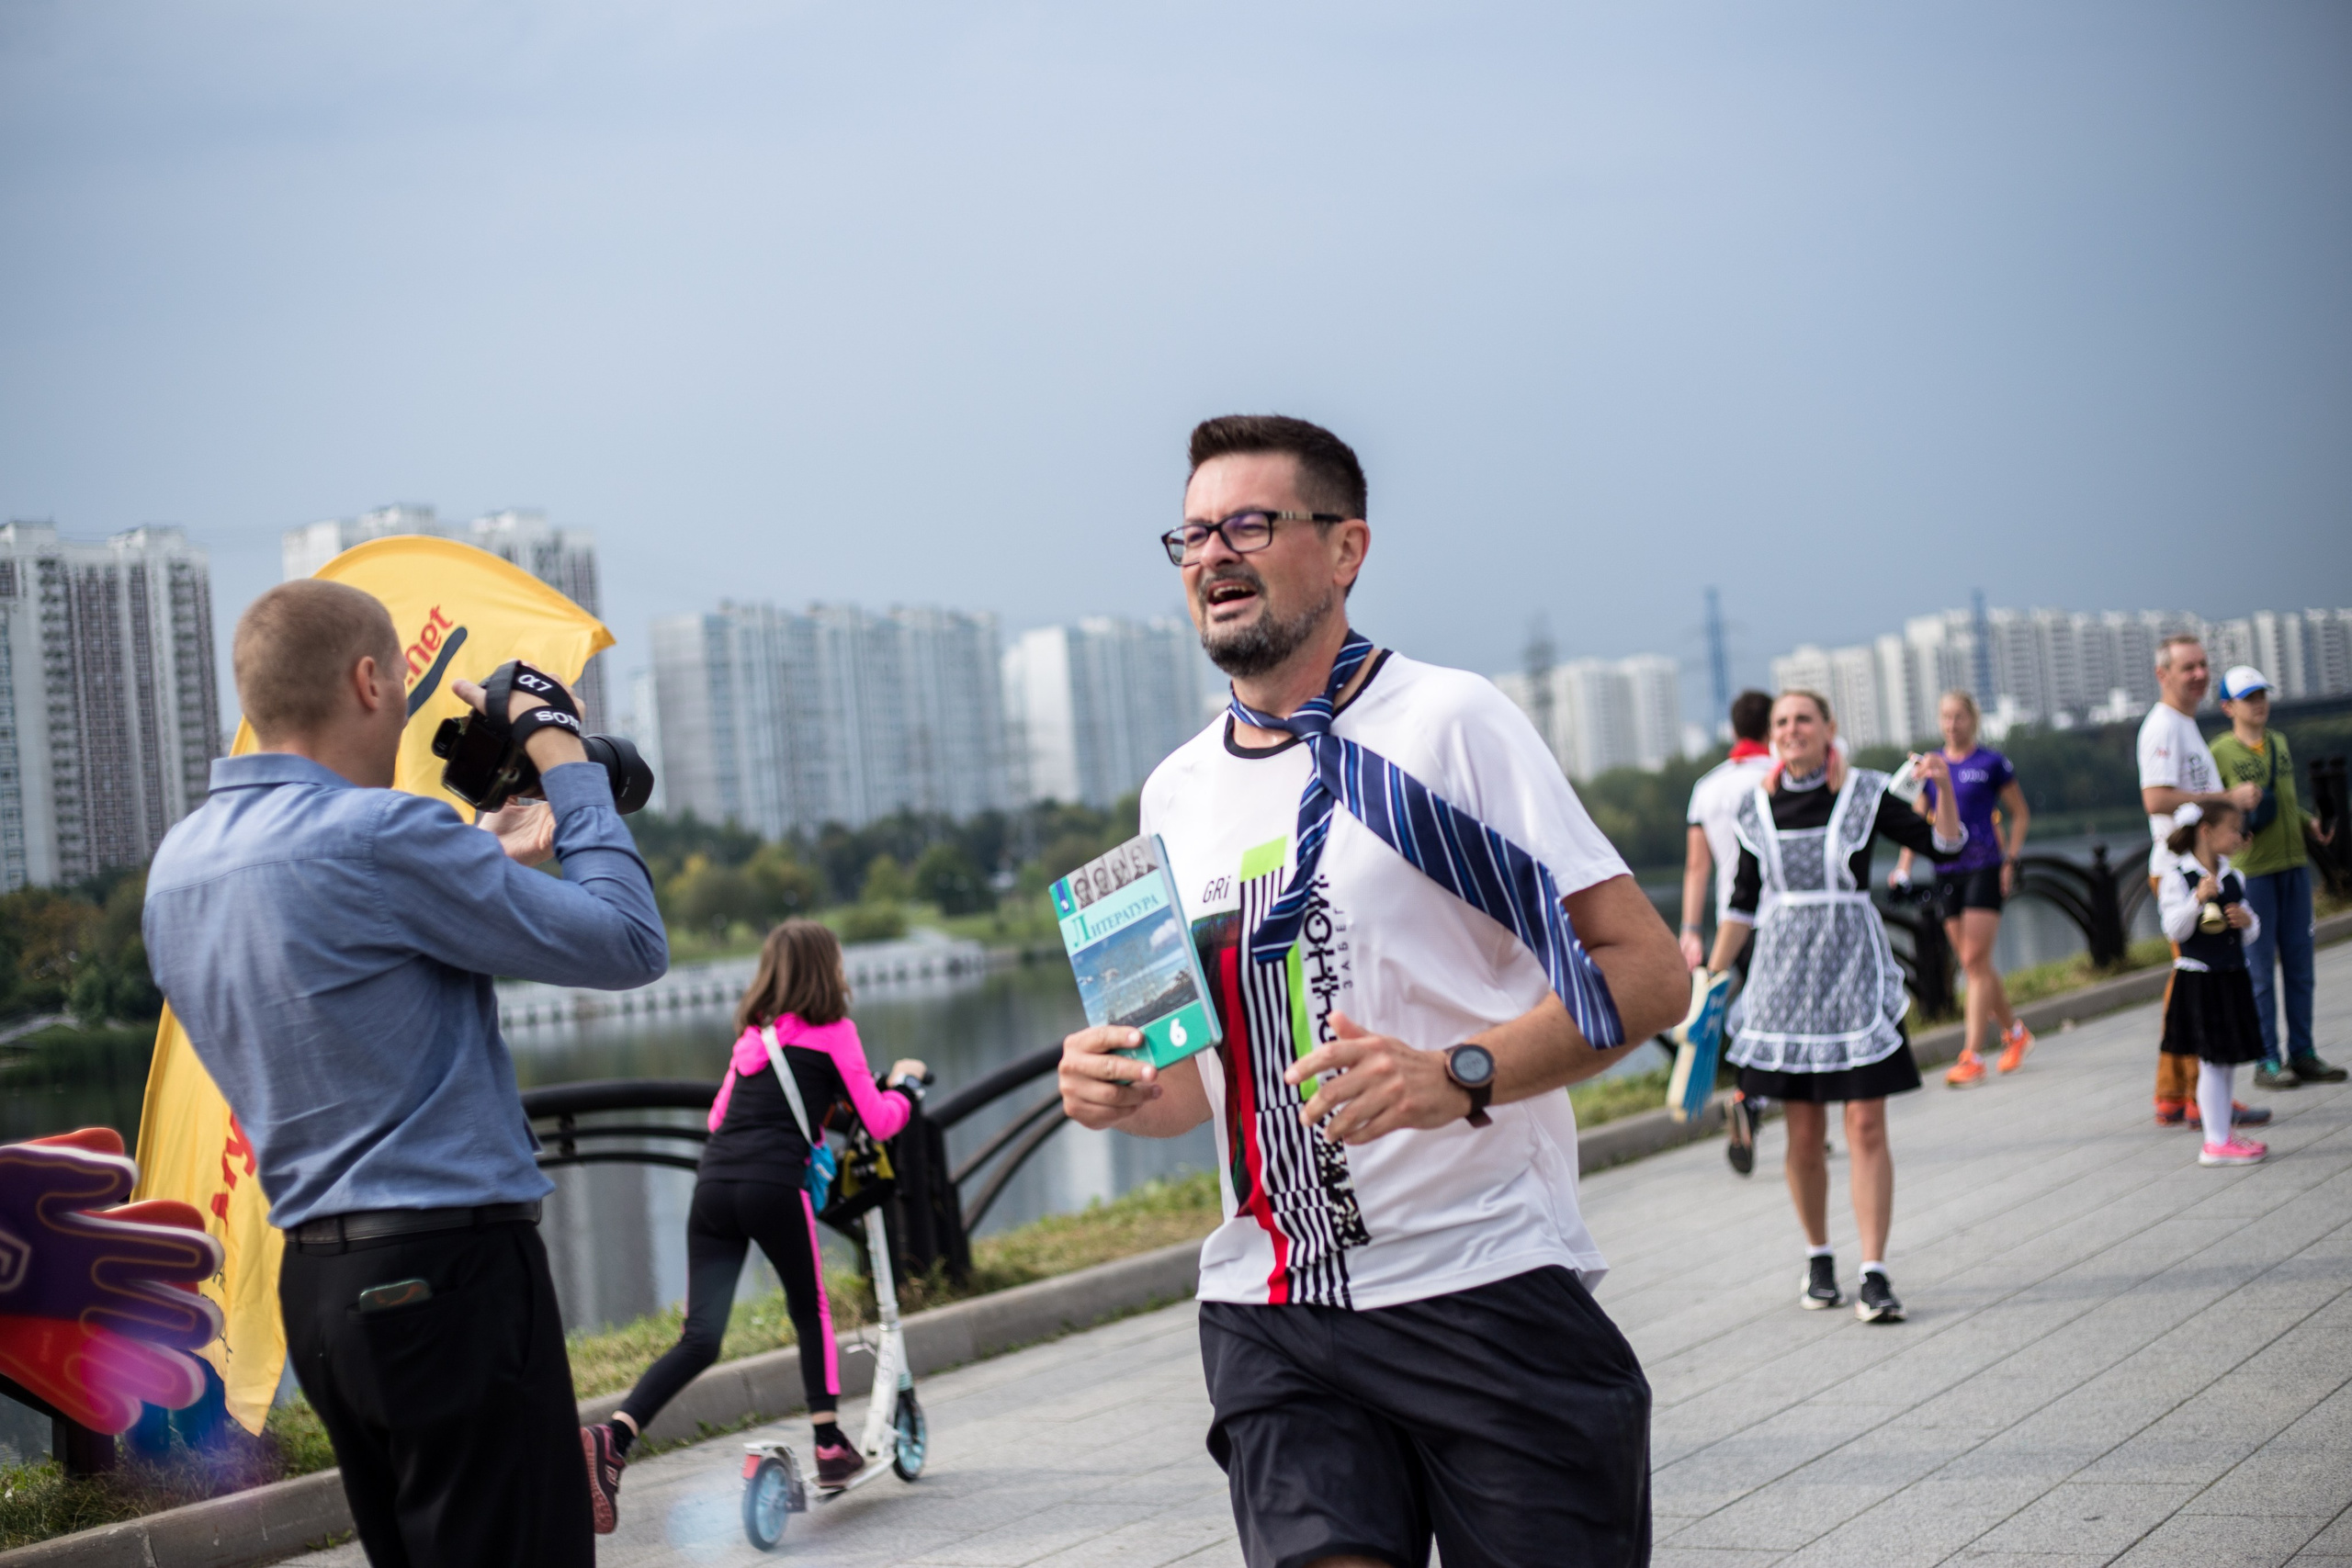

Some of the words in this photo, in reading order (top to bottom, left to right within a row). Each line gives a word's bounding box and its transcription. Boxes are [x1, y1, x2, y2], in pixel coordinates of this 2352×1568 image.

[536, 710, 580, 731] SON
[1334, 908, 1353, 989] ЗАБЕГ
[1169, 1018, 1188, 1047] 6
